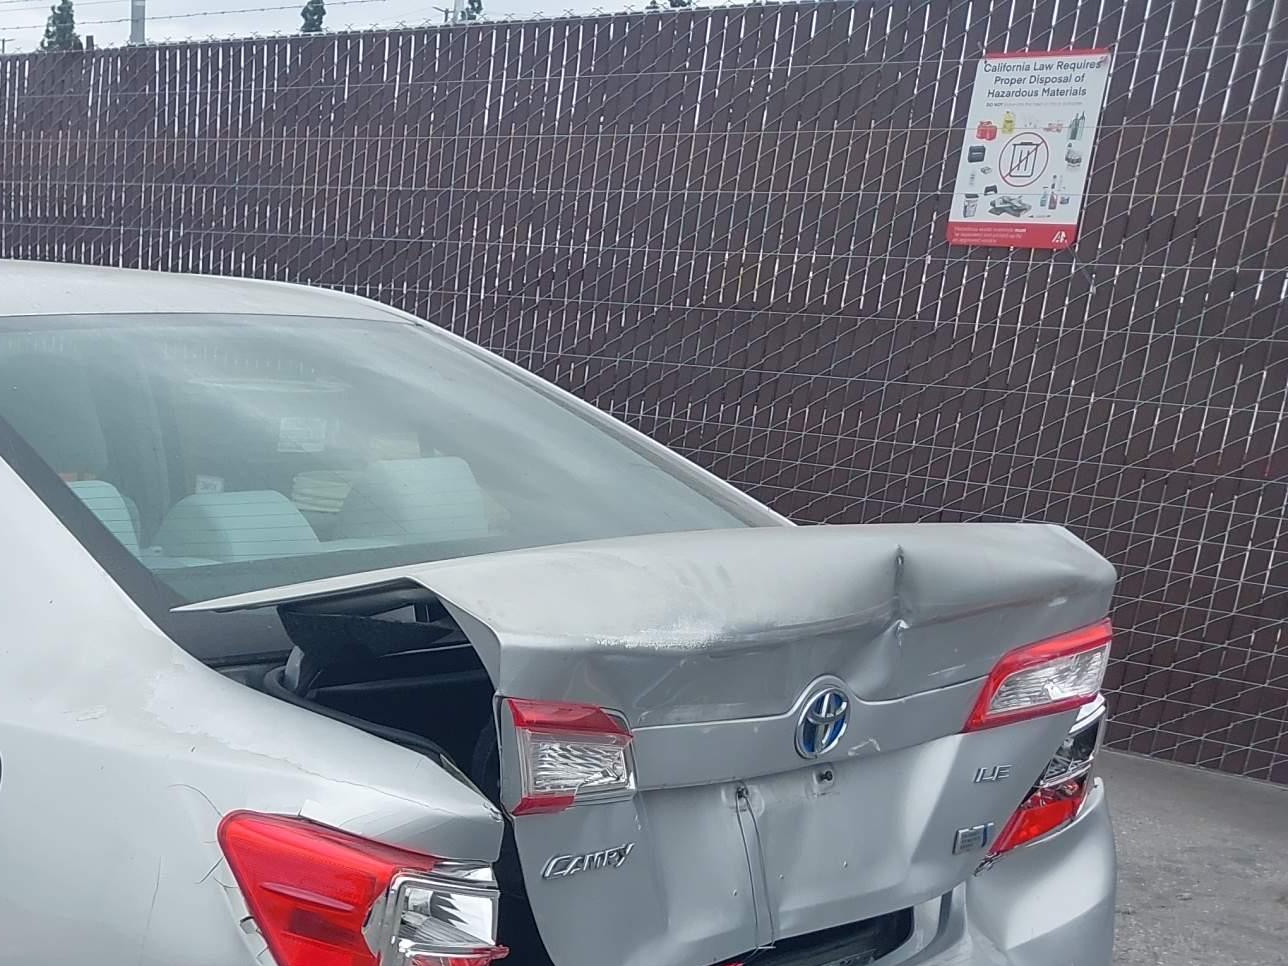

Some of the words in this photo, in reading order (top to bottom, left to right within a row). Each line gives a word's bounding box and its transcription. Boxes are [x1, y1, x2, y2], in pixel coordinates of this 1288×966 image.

[983, 62, 1031, 73] California
[1033, 60, 1054, 71] Law
[1056, 58, 1102, 72] Requires
[994, 76, 1027, 86] Proper
[1029, 73, 1072, 85] Disposal
[1074, 73, 1085, 83] of
[987, 88, 1039, 98] Hazardous
[1041, 86, 1087, 97] Materials
[971, 764, 1012, 784] LE
[539, 842, 635, 879] CAMRY
